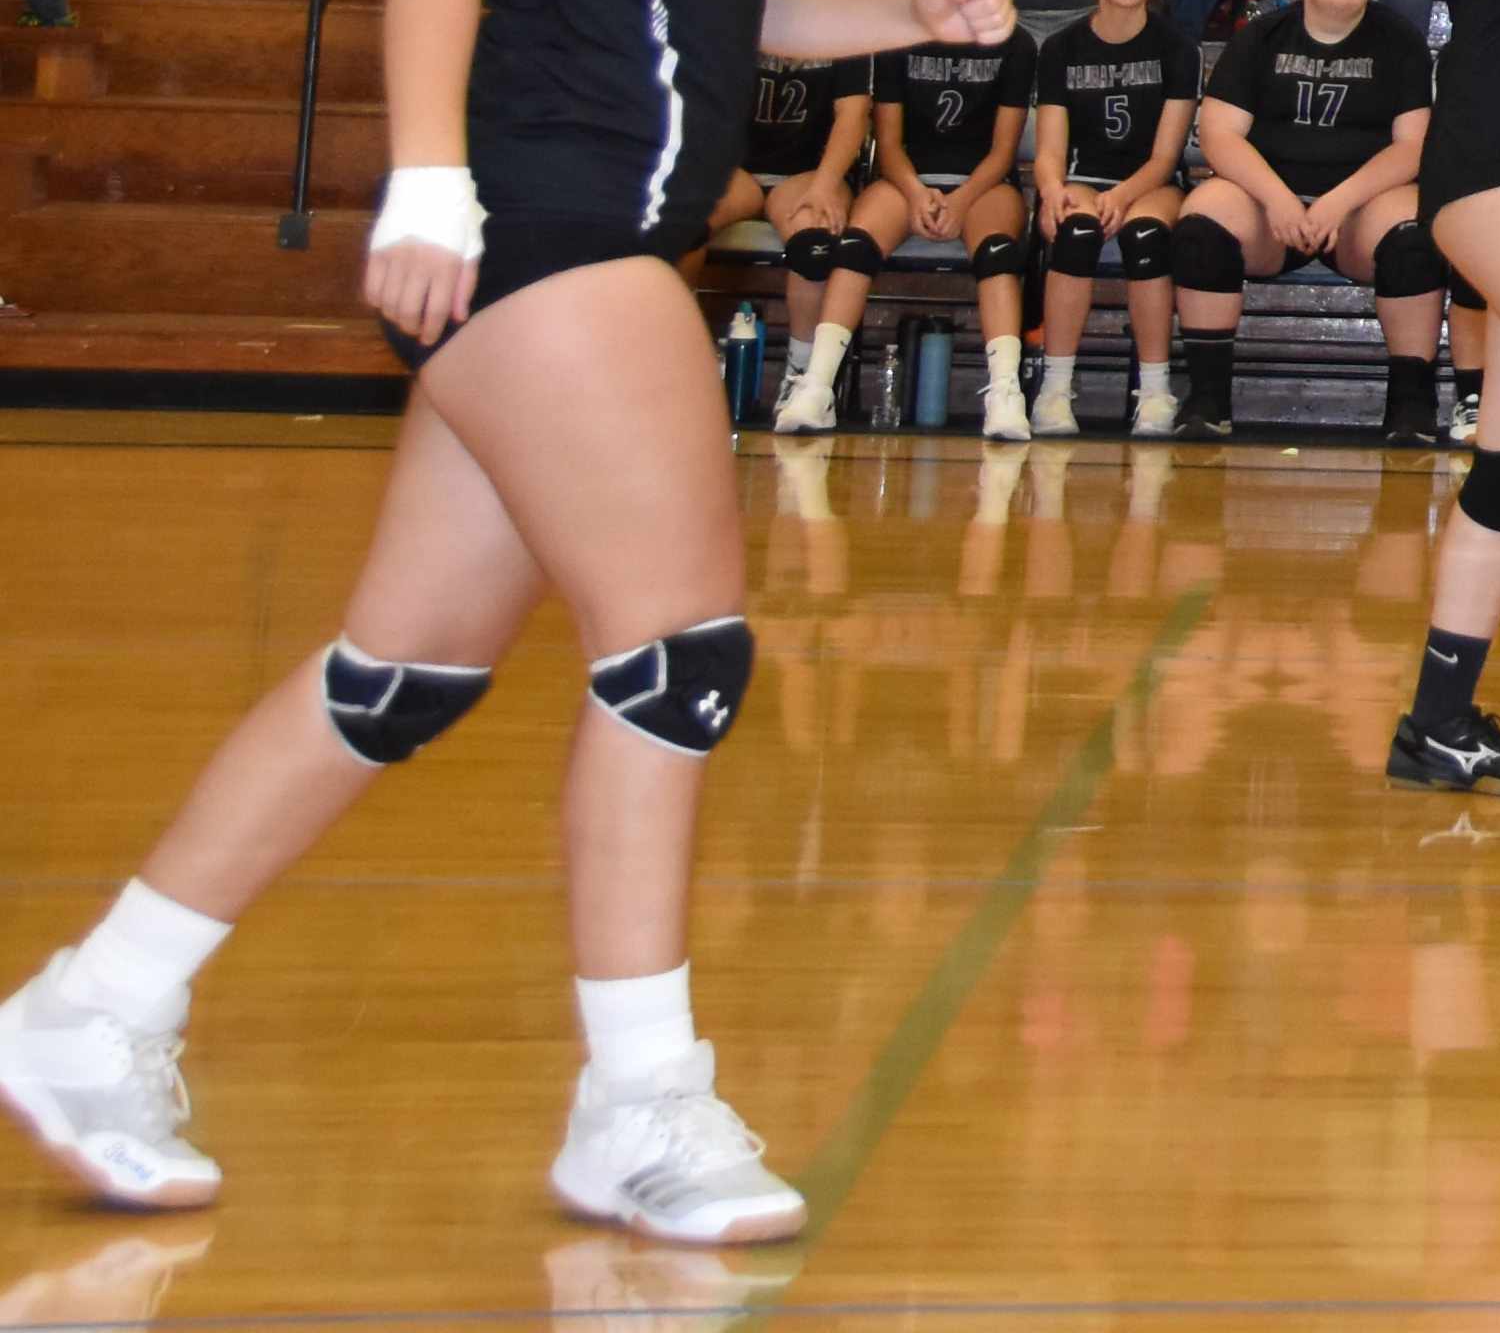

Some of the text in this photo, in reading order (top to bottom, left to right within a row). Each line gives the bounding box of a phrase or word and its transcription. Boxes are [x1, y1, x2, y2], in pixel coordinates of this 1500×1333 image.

[755, 77, 808, 124] 12
[933, 88, 964, 132] 2
[1104, 94, 1132, 140] 5
[1293, 80, 1348, 127] 17
